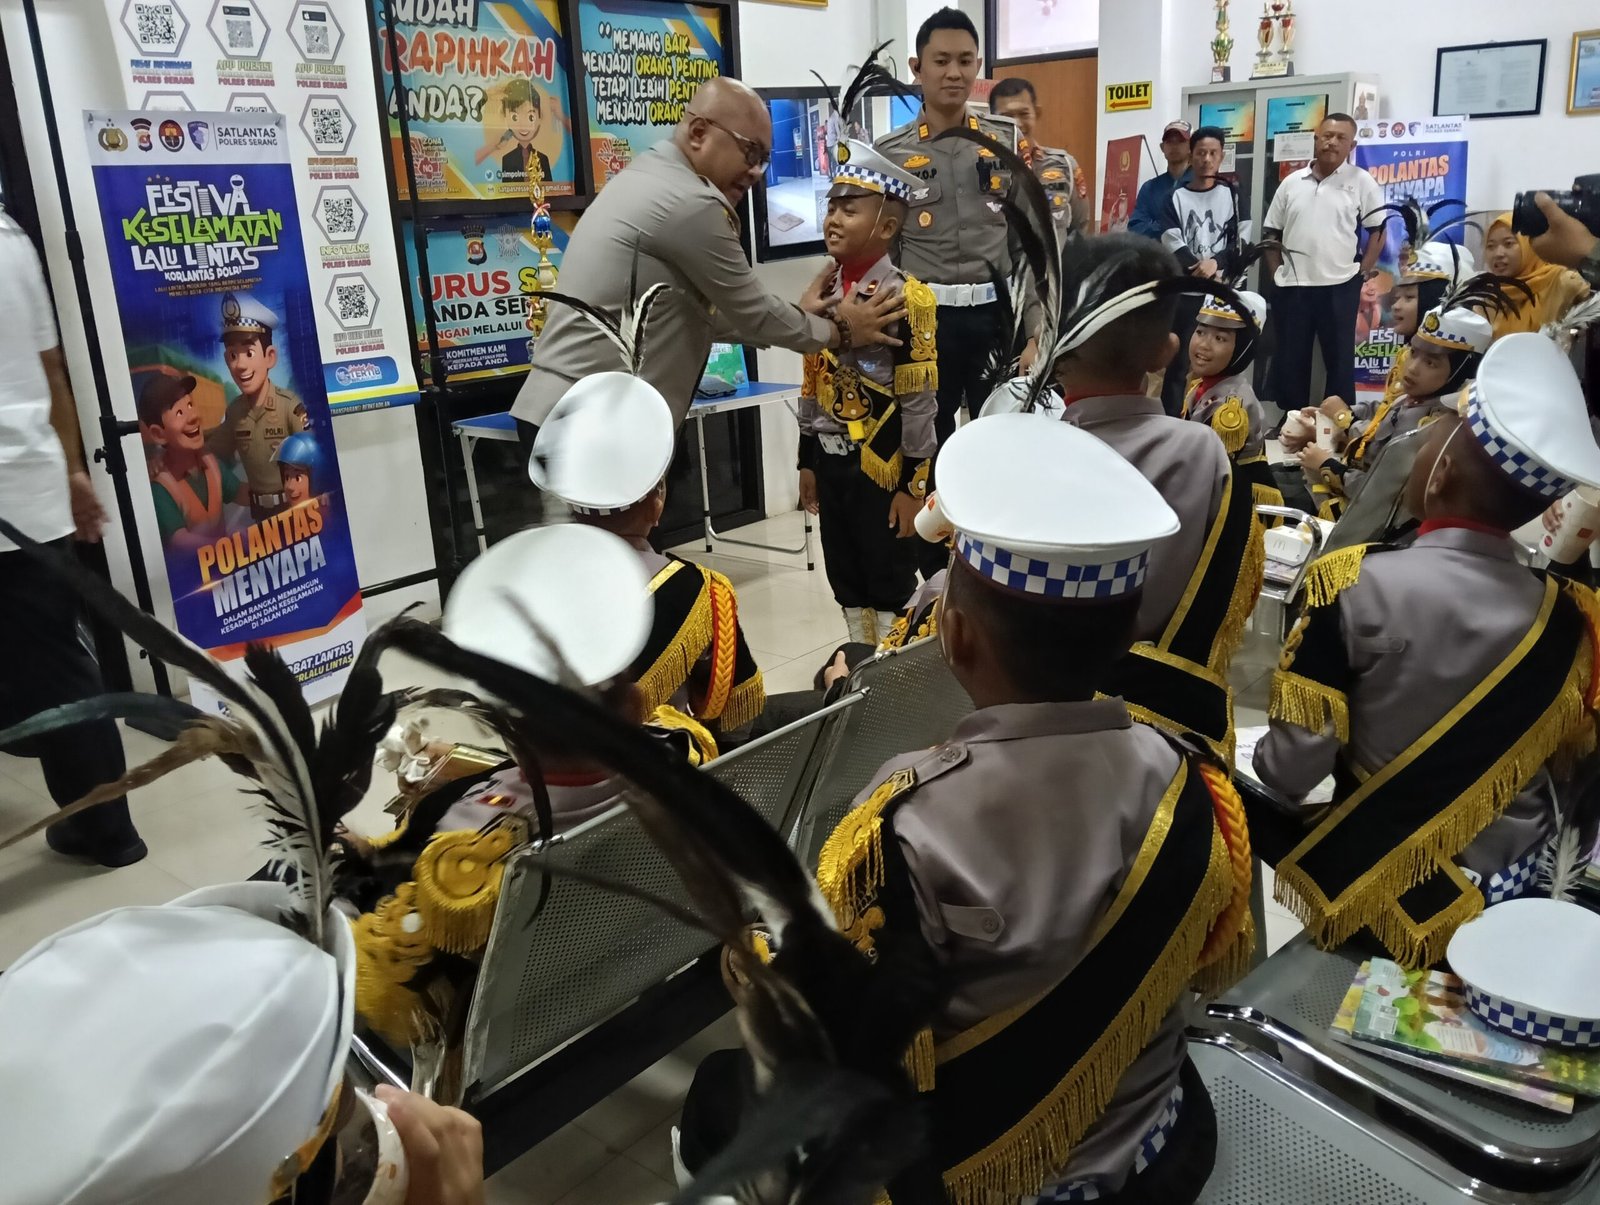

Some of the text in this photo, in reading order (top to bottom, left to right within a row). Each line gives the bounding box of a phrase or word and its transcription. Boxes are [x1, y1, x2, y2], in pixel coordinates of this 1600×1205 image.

[380, 30, 556, 82] RAPIHKAH
[663, 33, 690, 55] BAIK
[634, 55, 674, 78] ORANG
[676, 58, 721, 80] PENTING
[592, 77, 630, 100] TETAPI
[632, 79, 667, 101] LEBIH
[1108, 83, 1150, 100] TOILET
[596, 101, 686, 123] MENJADI ORANG
[217, 127, 277, 140] SATLANTAS
[1425, 122, 1463, 131] SATLANTAS
[218, 137, 279, 147] POLRES SERANG
[1393, 150, 1427, 158] POLRI
[1368, 154, 1450, 187] POLANTAS
[145, 176, 261, 218] FESTIVAL
[1384, 175, 1446, 205] ENYAPA
[121, 207, 283, 248] KESELAMATAN
[131, 241, 279, 272] LALU LINTAS
[164, 266, 243, 283] KORLANTAS POLRI
[418, 270, 511, 302] URUS
[419, 328, 470, 344] JNGAN
[473, 321, 523, 336] MELALUI
[445, 343, 508, 360] KOMITMEN KAMI
[1354, 356, 1381, 369] LALU
[447, 357, 510, 371] KEPADA ANDA
[265, 427, 285, 437] POLRI
[198, 500, 323, 585] POLANTAS
[212, 535, 327, 618] MENYAPA
[220, 584, 324, 635] KESADARAN DAN KESELAMATAN
[223, 578, 320, 626] DALAM RANGKA MEMBANGUN
[251, 604, 299, 630] DI JALAN RAYA
[314, 642, 354, 667] LANTAS
[325, 654, 354, 672] LINTAS
